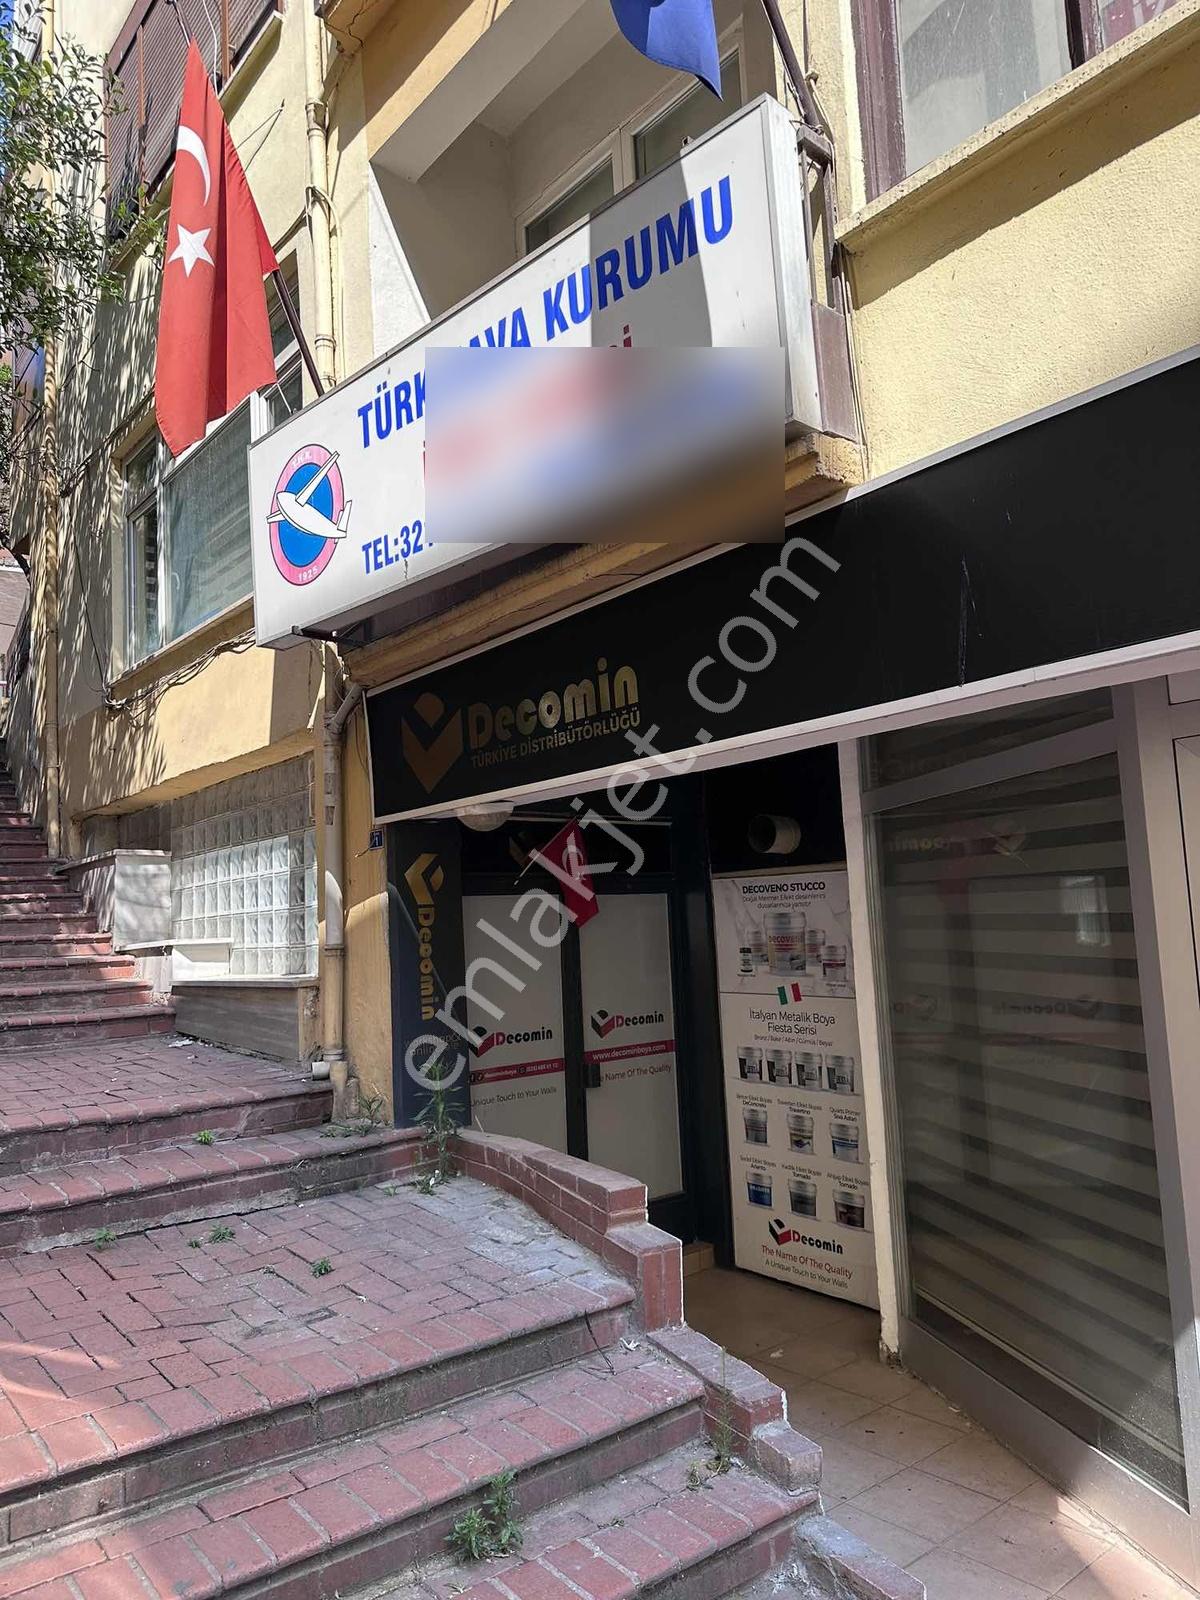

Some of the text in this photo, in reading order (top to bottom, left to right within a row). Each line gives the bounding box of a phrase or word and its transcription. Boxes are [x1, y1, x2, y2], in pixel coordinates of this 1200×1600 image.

[543, 175, 733, 341] KURUMU
[298, 569, 319, 582] 1925
[468, 657, 639, 750] Decomin
[471, 707, 641, 769] TÜRKİYE DİSTRİBÜTÖRLÜĞÜ
[742, 881, 826, 894] DECOVENO STUCCO
[418, 906, 439, 1021] Decomin
[616, 1010, 664, 1028] Decomin
[779, 1011, 811, 1022] Metalik
[813, 1013, 836, 1026] Boya
[494, 1027, 553, 1046] Decomin
[767, 1022, 817, 1036] Fiesta Serisi
[605, 1072, 626, 1082] Name
[627, 1069, 635, 1078] Of
[649, 1065, 672, 1077] Quality
[496, 1090, 517, 1103] Touch
[525, 1086, 540, 1098] Your
[792, 1229, 843, 1254] Decomin
[761, 1244, 853, 1280] The Name Of The Quality
[770, 1260, 791, 1273] Unique
[792, 1265, 810, 1277] Touch
[817, 1273, 831, 1283] Your
[831, 1277, 849, 1288] Walls
